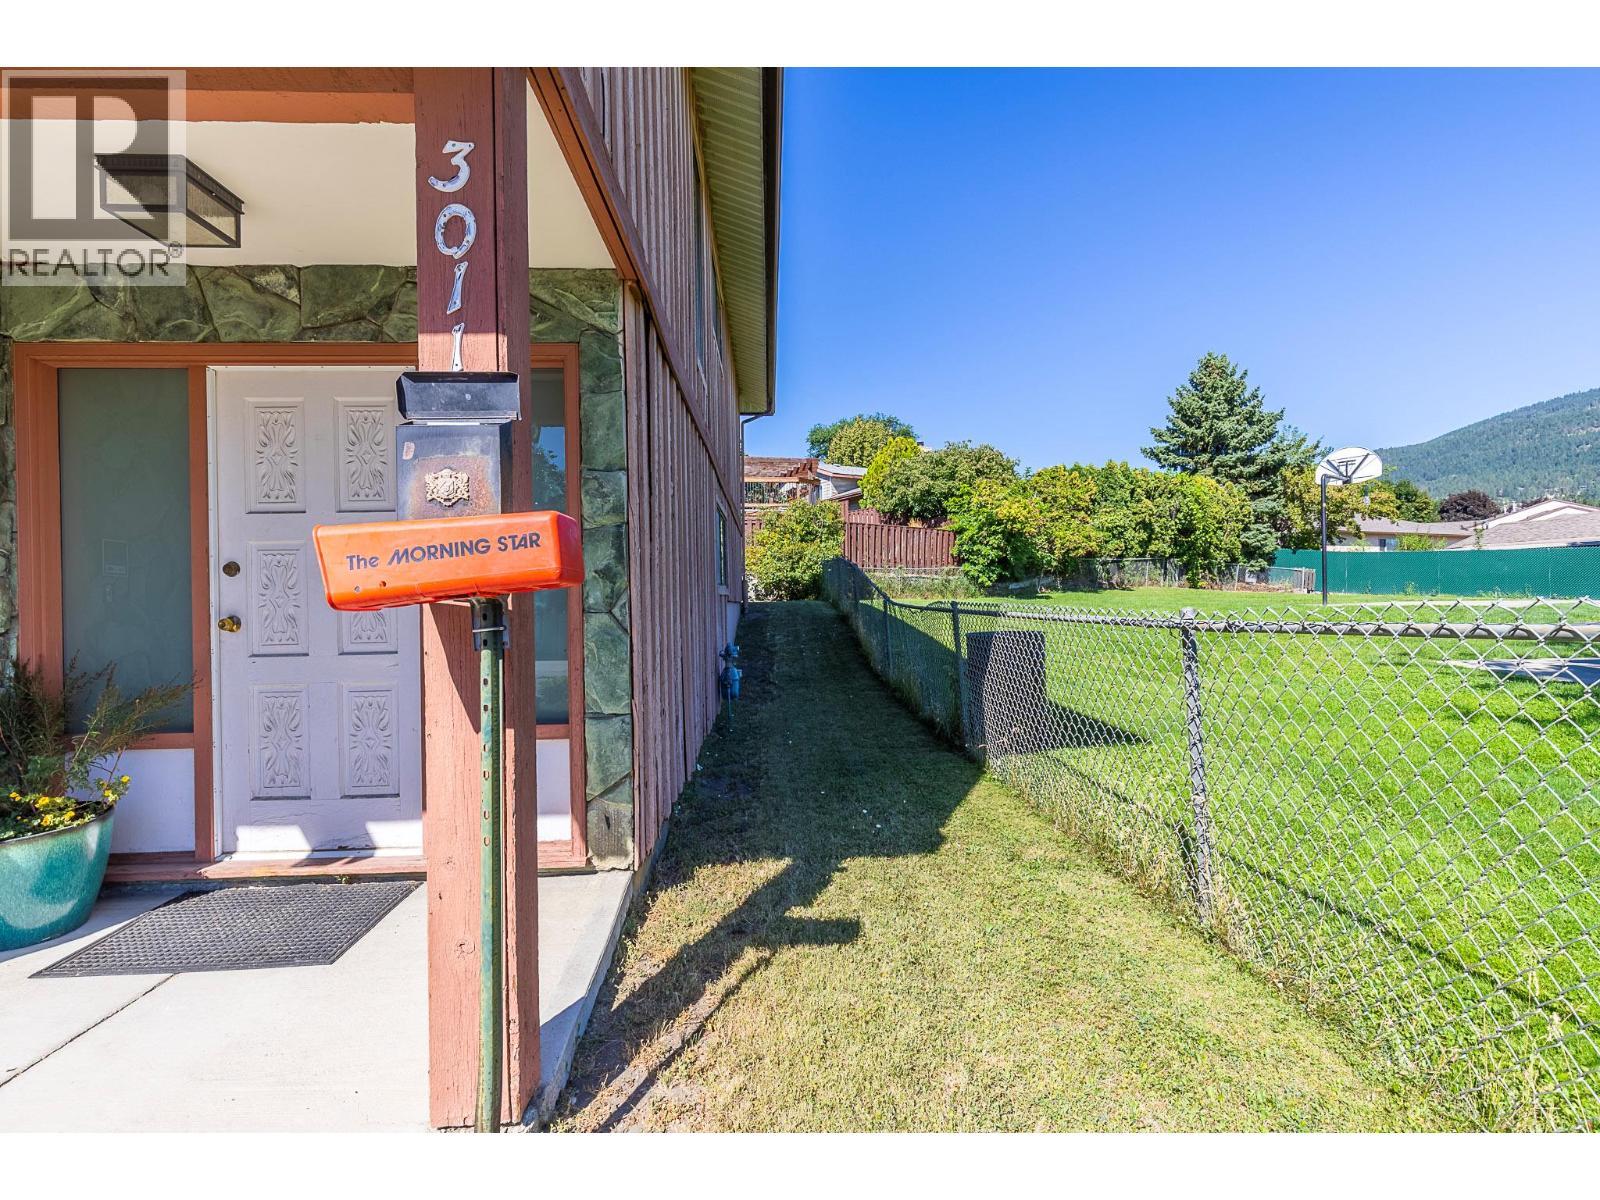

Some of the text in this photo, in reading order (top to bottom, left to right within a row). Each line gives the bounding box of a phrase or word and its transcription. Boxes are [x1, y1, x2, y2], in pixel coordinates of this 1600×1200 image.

[427, 139, 477, 372] 3011
[346, 532, 541, 571] The MORNING STAR
